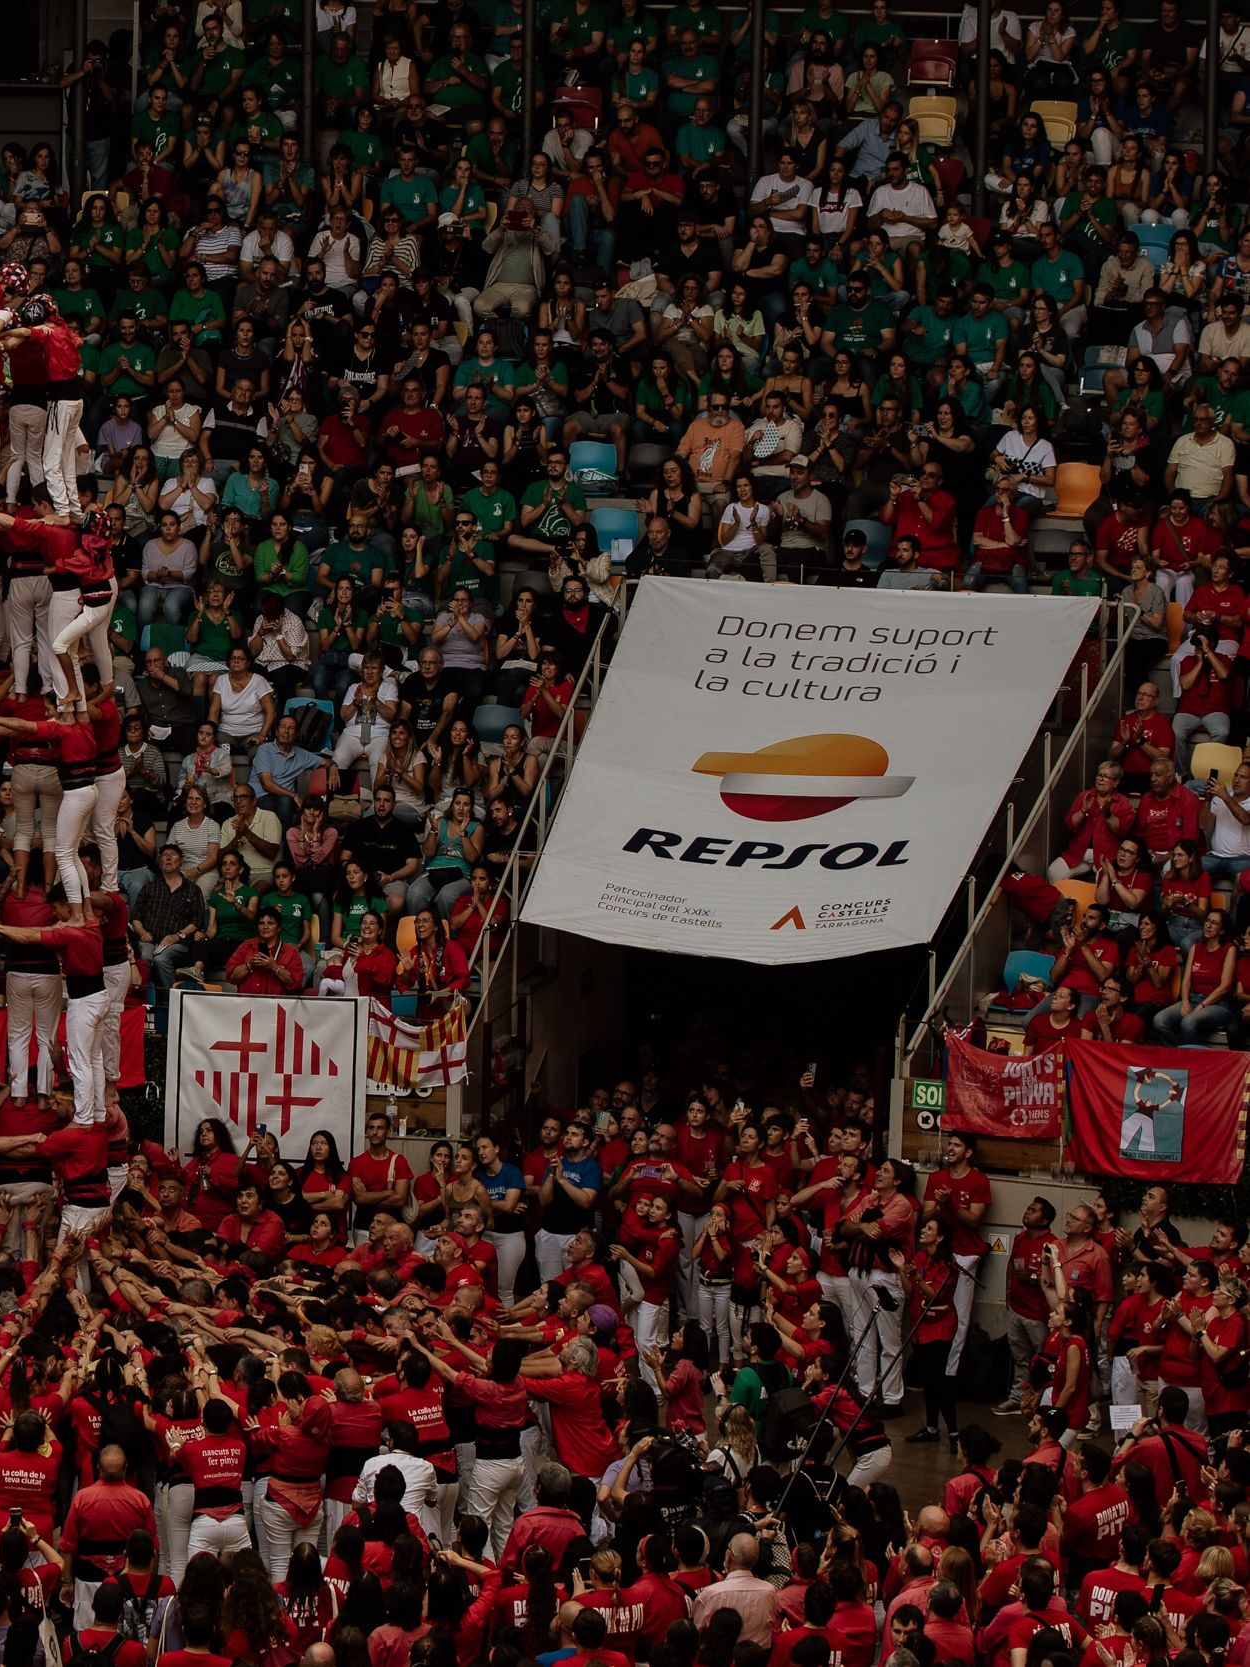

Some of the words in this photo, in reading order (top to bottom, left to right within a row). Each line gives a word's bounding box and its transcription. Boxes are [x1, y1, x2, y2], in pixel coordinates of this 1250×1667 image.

[344, 368, 376, 384] FOLKCORE
[716, 615, 856, 643] Donem
[869, 623, 999, 650] suport
[704, 647, 727, 664] a
[742, 646, 775, 668] la
[790, 647, 938, 674] tradició
[950, 653, 960, 673] i
[695, 669, 728, 693] la
[742, 677, 882, 702] cultura
[622, 828, 910, 870] REPSOL
[605, 882, 688, 904] Patrocinador
[600, 892, 656, 910] principal
[659, 903, 680, 913] del
[684, 906, 711, 917] XXIX
[818, 906, 888, 918] CASTELLS
[821, 899, 892, 911] CONCURS
[597, 901, 649, 918] Concurs
[652, 912, 668, 921] de
[671, 915, 722, 928] Castells
[814, 918, 884, 929] TARRAGONA
[1001, 1054, 1055, 1078] JUNTS
[1003, 1082, 1055, 1107] PINYA
[1028, 1109, 1050, 1119] NENS
[417, 1407, 431, 1416] colla
[427, 1412, 442, 1420] ciutat
[230, 1448, 241, 1456] per
[208, 1457, 218, 1466] fer
[220, 1458, 238, 1467] pinya
[11, 1470, 28, 1478] colla
[29, 1471, 38, 1479] de
[39, 1472, 46, 1480] la
[21, 1477, 42, 1486] ciutat
[1097, 1517, 1125, 1540] PIT
